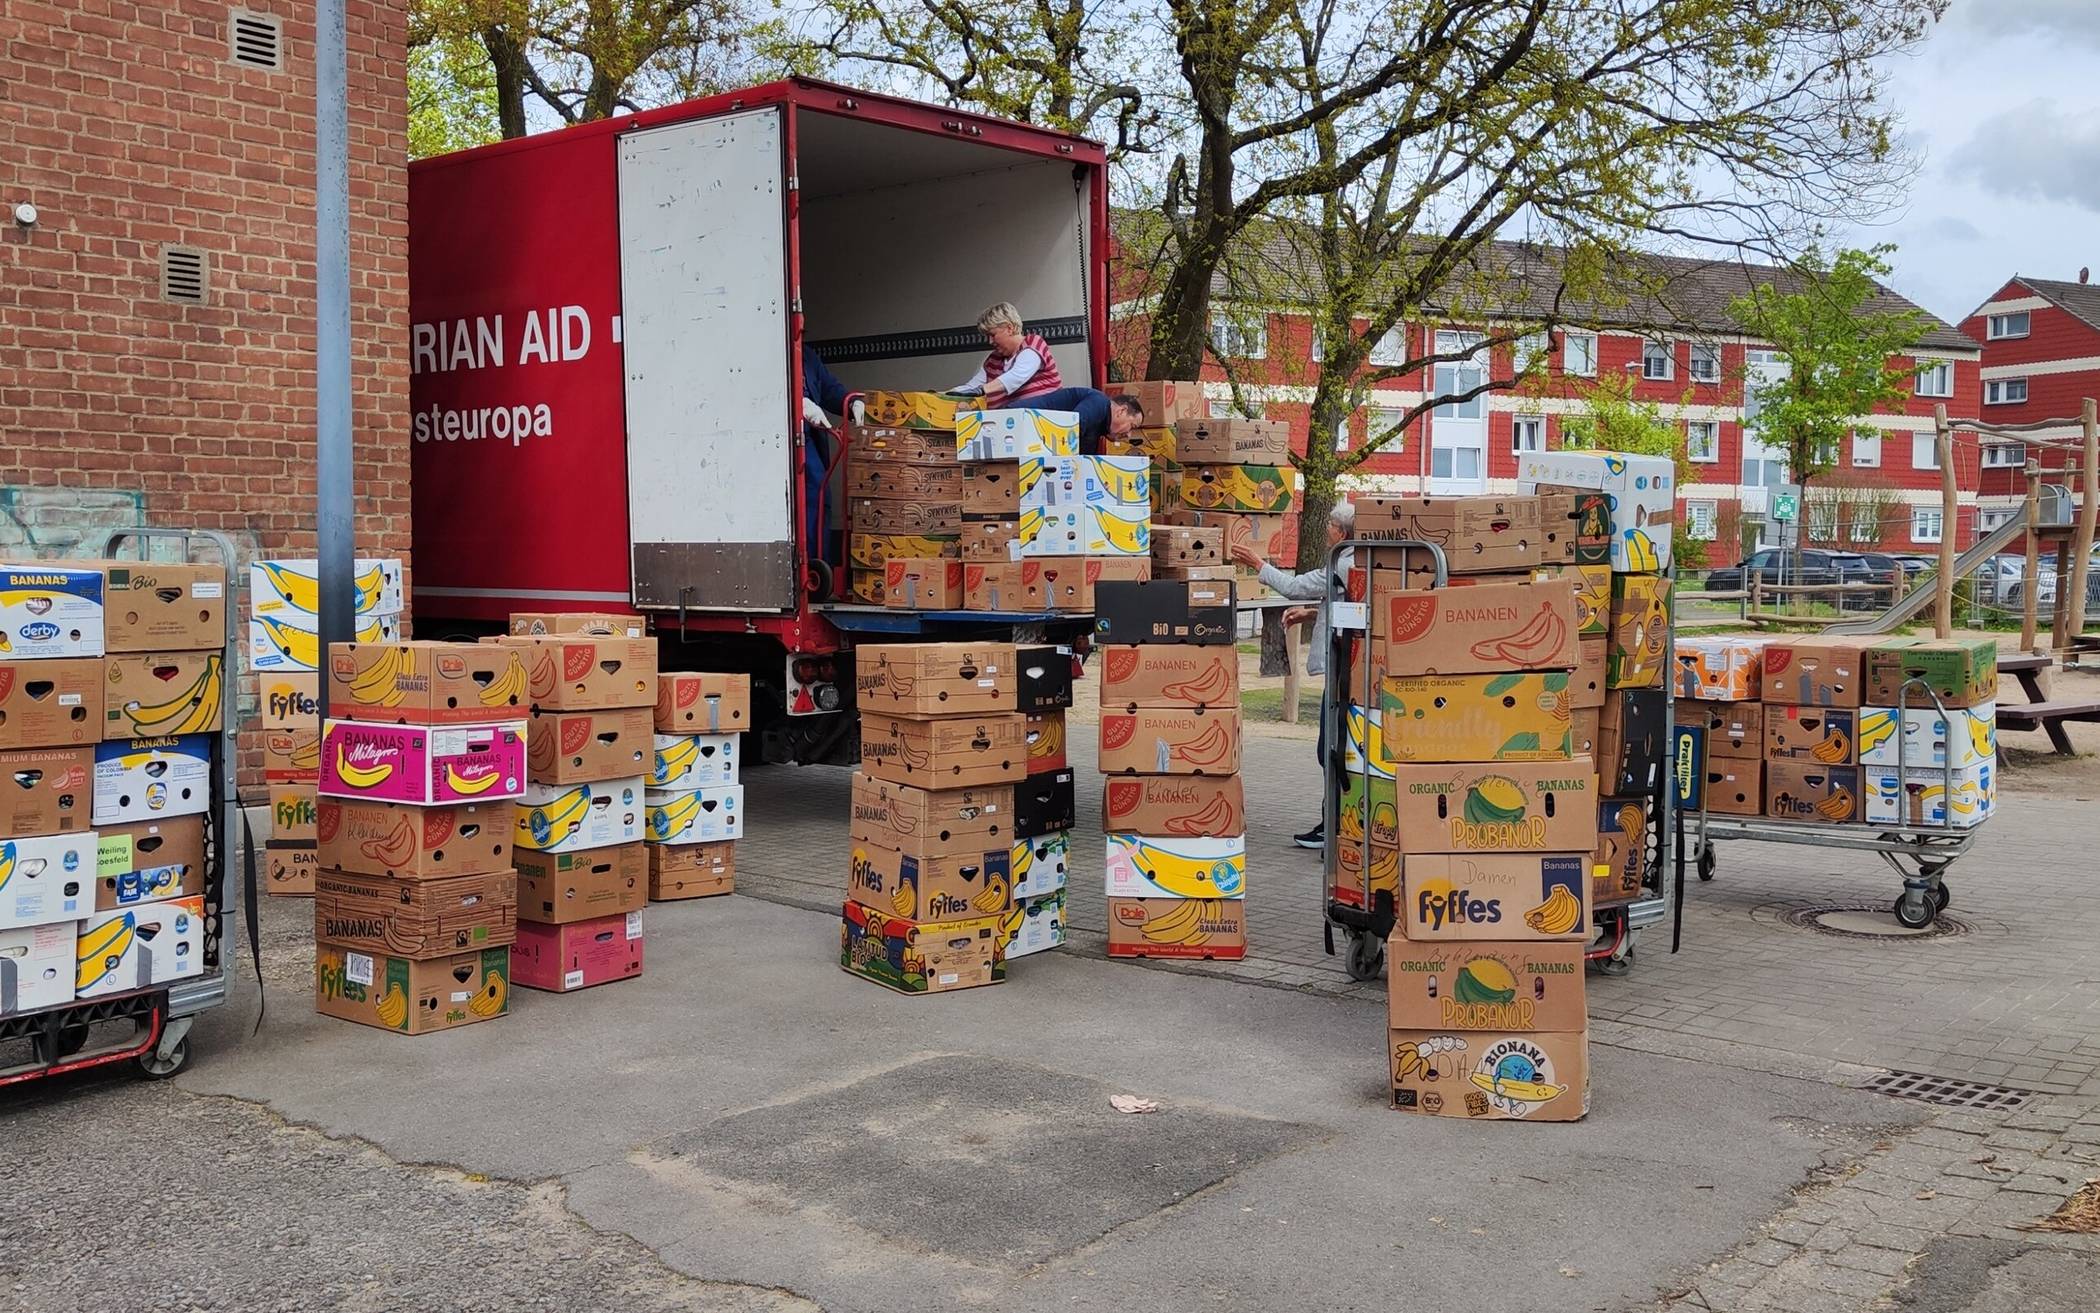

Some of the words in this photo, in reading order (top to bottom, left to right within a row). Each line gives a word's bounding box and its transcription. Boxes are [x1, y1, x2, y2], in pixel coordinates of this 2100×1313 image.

[413, 314, 504, 374] RIAN
[519, 305, 591, 365] AID
[415, 403, 552, 447] steuropa
[1236, 439, 1264, 451] BANANAS
[10, 575, 68, 586] BANANAS
[131, 575, 157, 591] Bio
[1396, 599, 1430, 635] GÜNSTIG
[1445, 606, 1518, 624] BANANEN
[21, 622, 59, 639] derby
[1144, 660, 1197, 671] BANANEN
[396, 681, 428, 692] BANANAS
[858, 673, 886, 690] BANANAS
[1430, 679, 1466, 687] ORGANIC
[1144, 719, 1196, 729] BANANEN
[131, 737, 179, 750] BANANAS
[271, 738, 292, 748] Dole
[344, 731, 405, 750] BANANAS
[31, 751, 77, 762] BANANAS
[349, 742, 398, 765] Milagros
[863, 743, 897, 757] BANANAS
[322, 735, 333, 782] ORGANIC
[456, 753, 502, 767] BANANAS
[462, 764, 493, 777] Milagros
[432, 756, 441, 801] ORGANIC
[1536, 779, 1585, 792] BANANAS
[1409, 782, 1455, 795] ORGANIC
[1148, 793, 1199, 804] BANANEN
[1773, 794, 1813, 815] fyffes
[347, 809, 388, 824] BANANEN
[855, 806, 888, 822] BANANAS
[1450, 815, 1547, 850] PROBANOR
[97, 855, 129, 866] oesfeld
[574, 857, 592, 870] Bio
[984, 853, 1010, 863] Bananas
[1543, 861, 1580, 870] Bananas
[1621, 845, 1639, 893] fyffes
[852, 855, 884, 894] fyffes
[1461, 859, 1517, 887] Damen
[348, 885, 379, 898] BANANAS
[929, 896, 968, 919] fyffes
[1120, 907, 1145, 918] Dole
[1418, 889, 1502, 931] fyffes
[326, 919, 383, 938] BANANAS
[1199, 925, 1238, 934] BANANAS
[1400, 960, 1446, 973] ORGANIC
[1527, 961, 1575, 974] BANANAS
[1440, 995, 1537, 1029] PROBANOR
[1484, 1040, 1547, 1069] BIONANA
[1463, 1090, 1487, 1102] GOOD
[1467, 1106, 1489, 1117] ONLY
